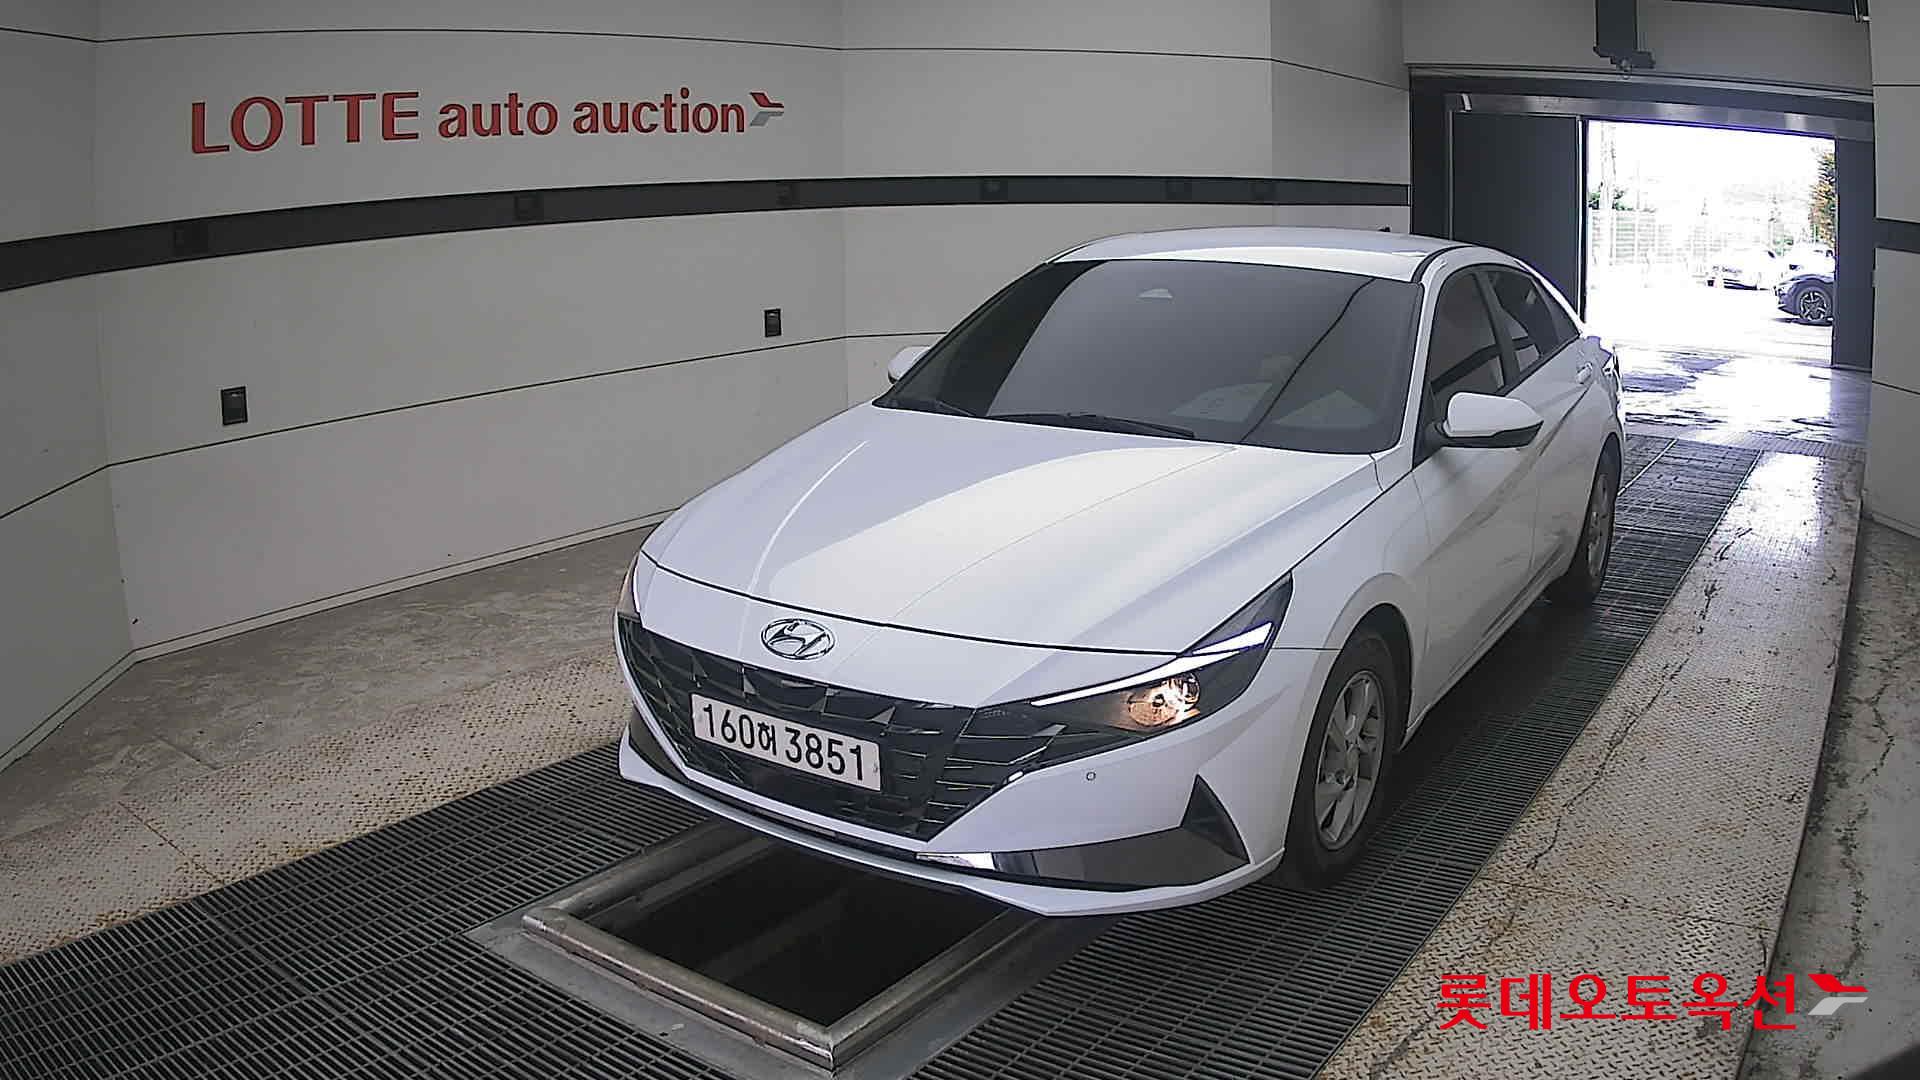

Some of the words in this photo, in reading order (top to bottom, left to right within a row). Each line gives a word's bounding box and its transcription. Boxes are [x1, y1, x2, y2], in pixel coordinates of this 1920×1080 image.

[191, 91, 420, 154] LOTTE
[438, 92, 559, 138] auto
[573, 87, 746, 134] auction
[703, 703, 777, 756] 160허
[785, 726, 863, 781] 3851
